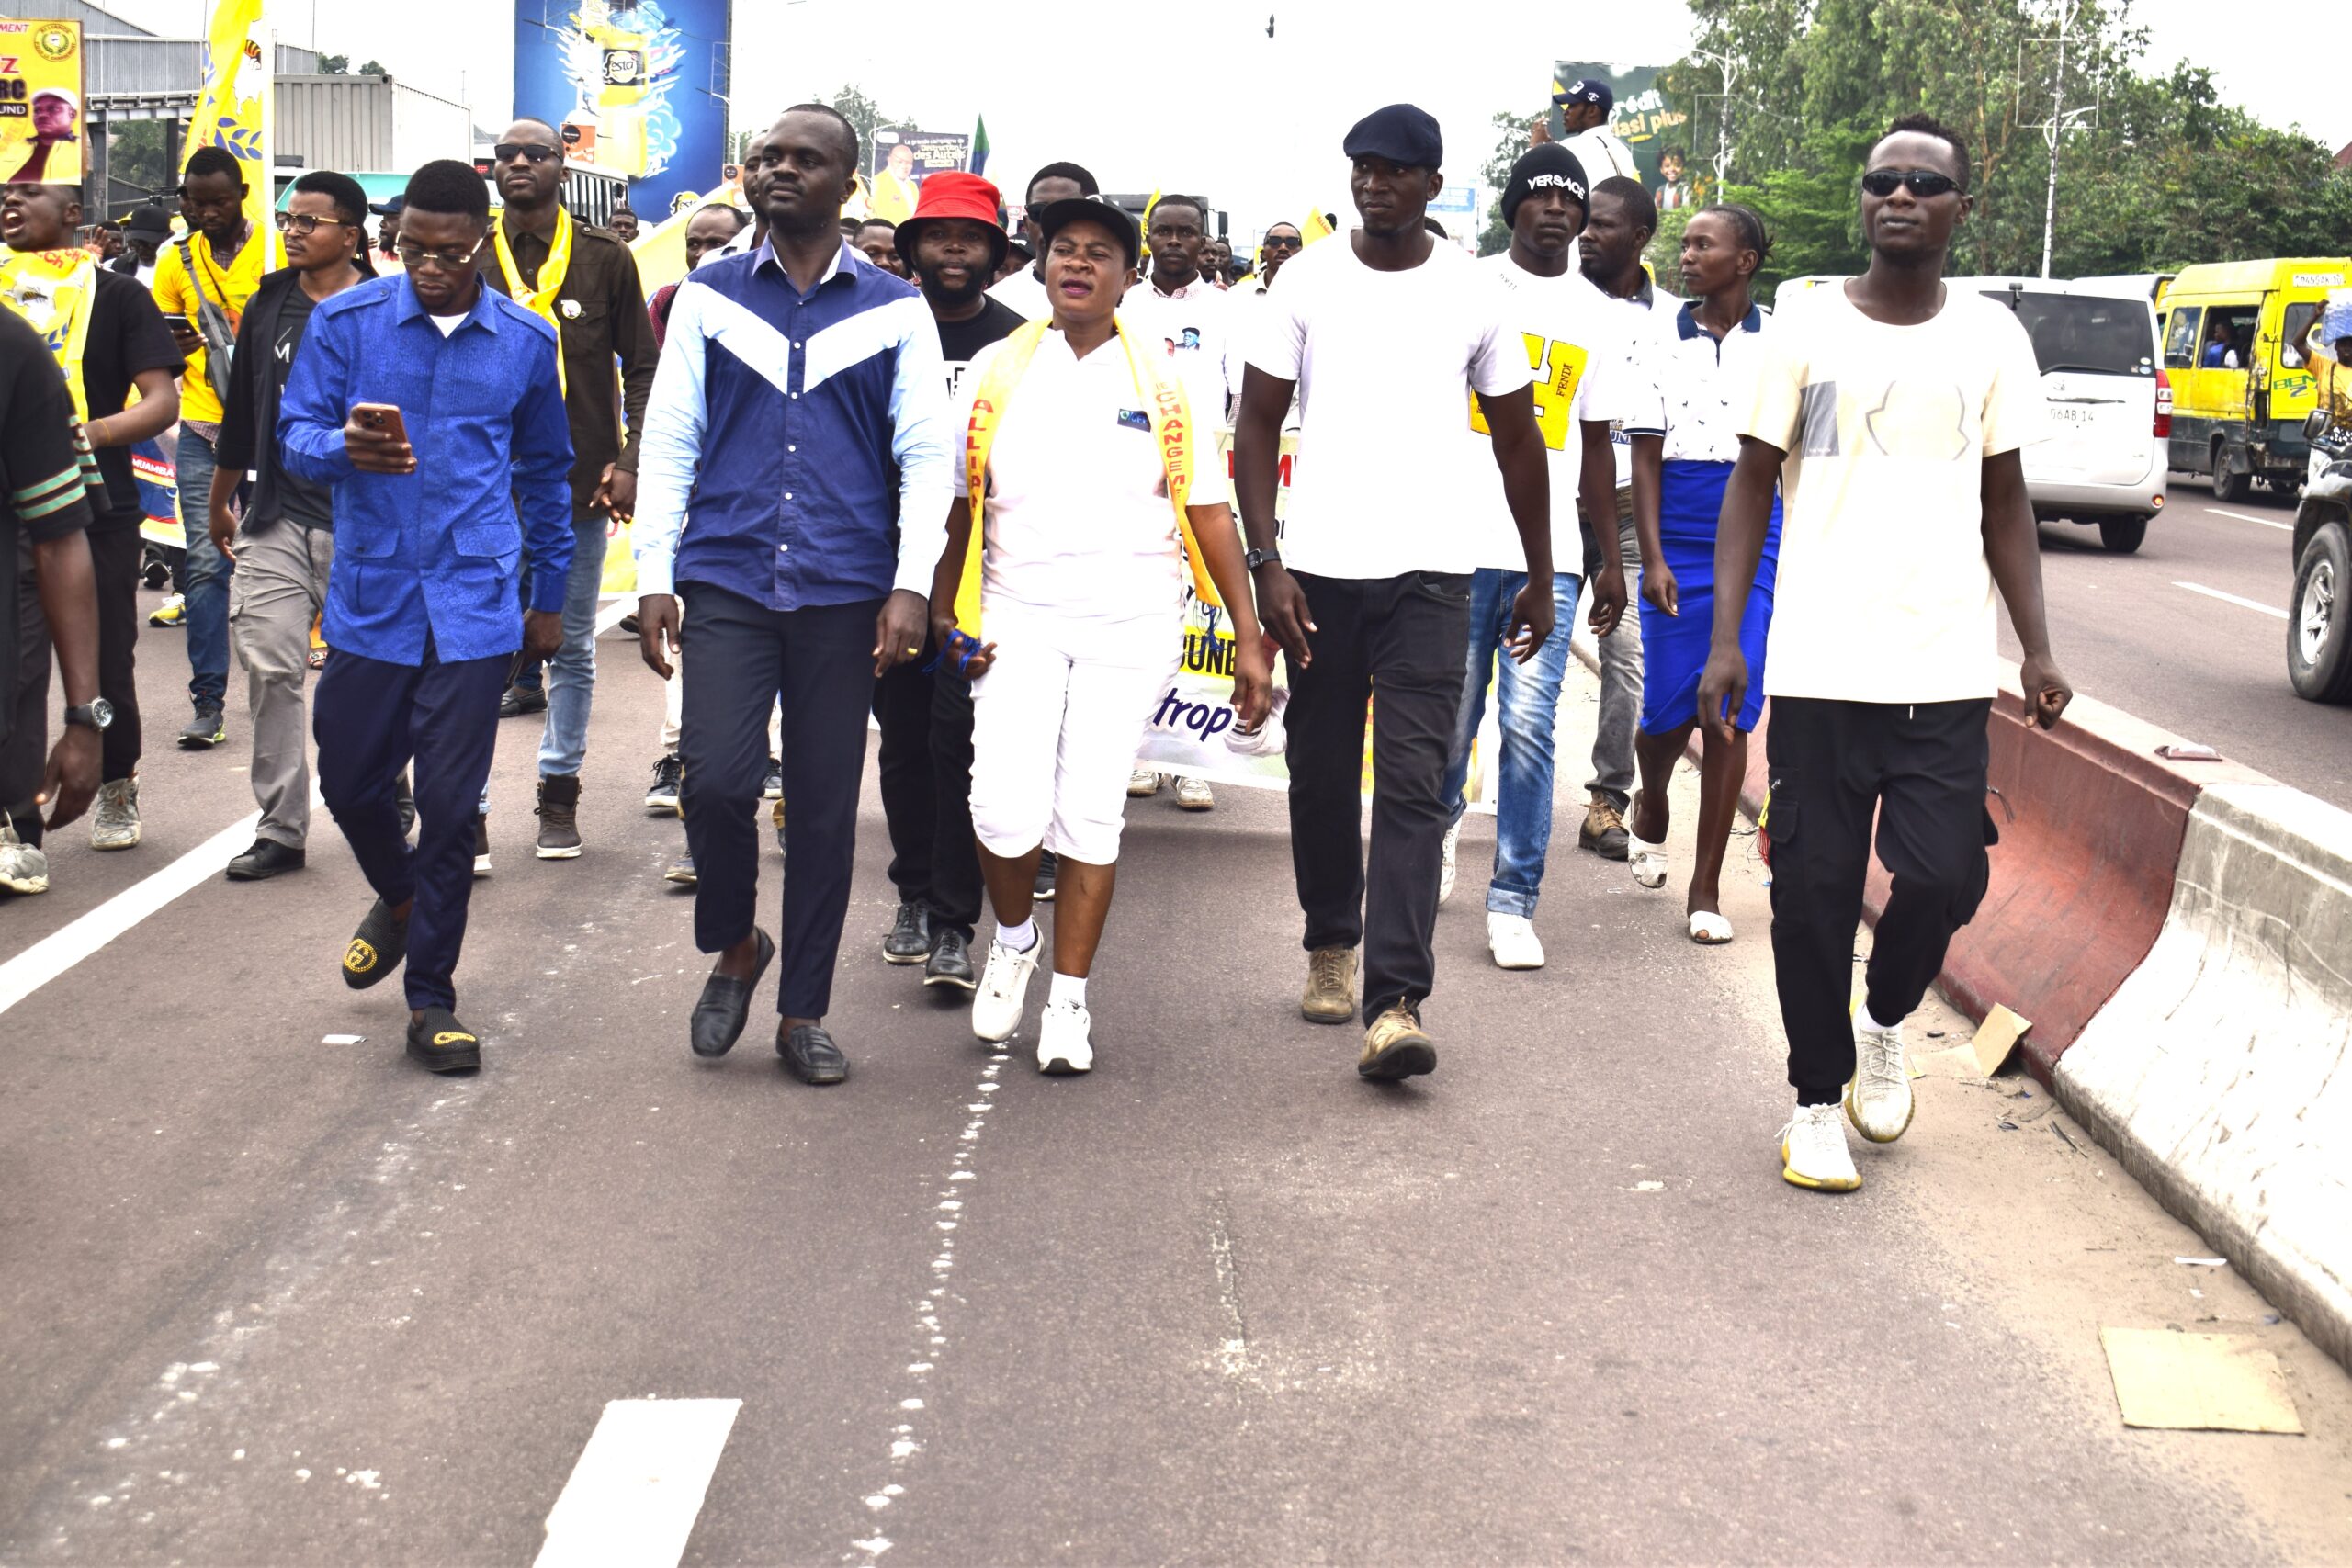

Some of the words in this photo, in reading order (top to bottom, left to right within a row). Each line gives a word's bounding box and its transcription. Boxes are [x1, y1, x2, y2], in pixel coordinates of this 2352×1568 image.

[1650, 108, 1687, 134] plus
[914, 150, 932, 160] des
[1527, 174, 1586, 200] VERSACE
[1556, 363, 1573, 397] FENDI
[132, 457, 175, 478] MUAMBA
[1152, 687, 1232, 742] trop
